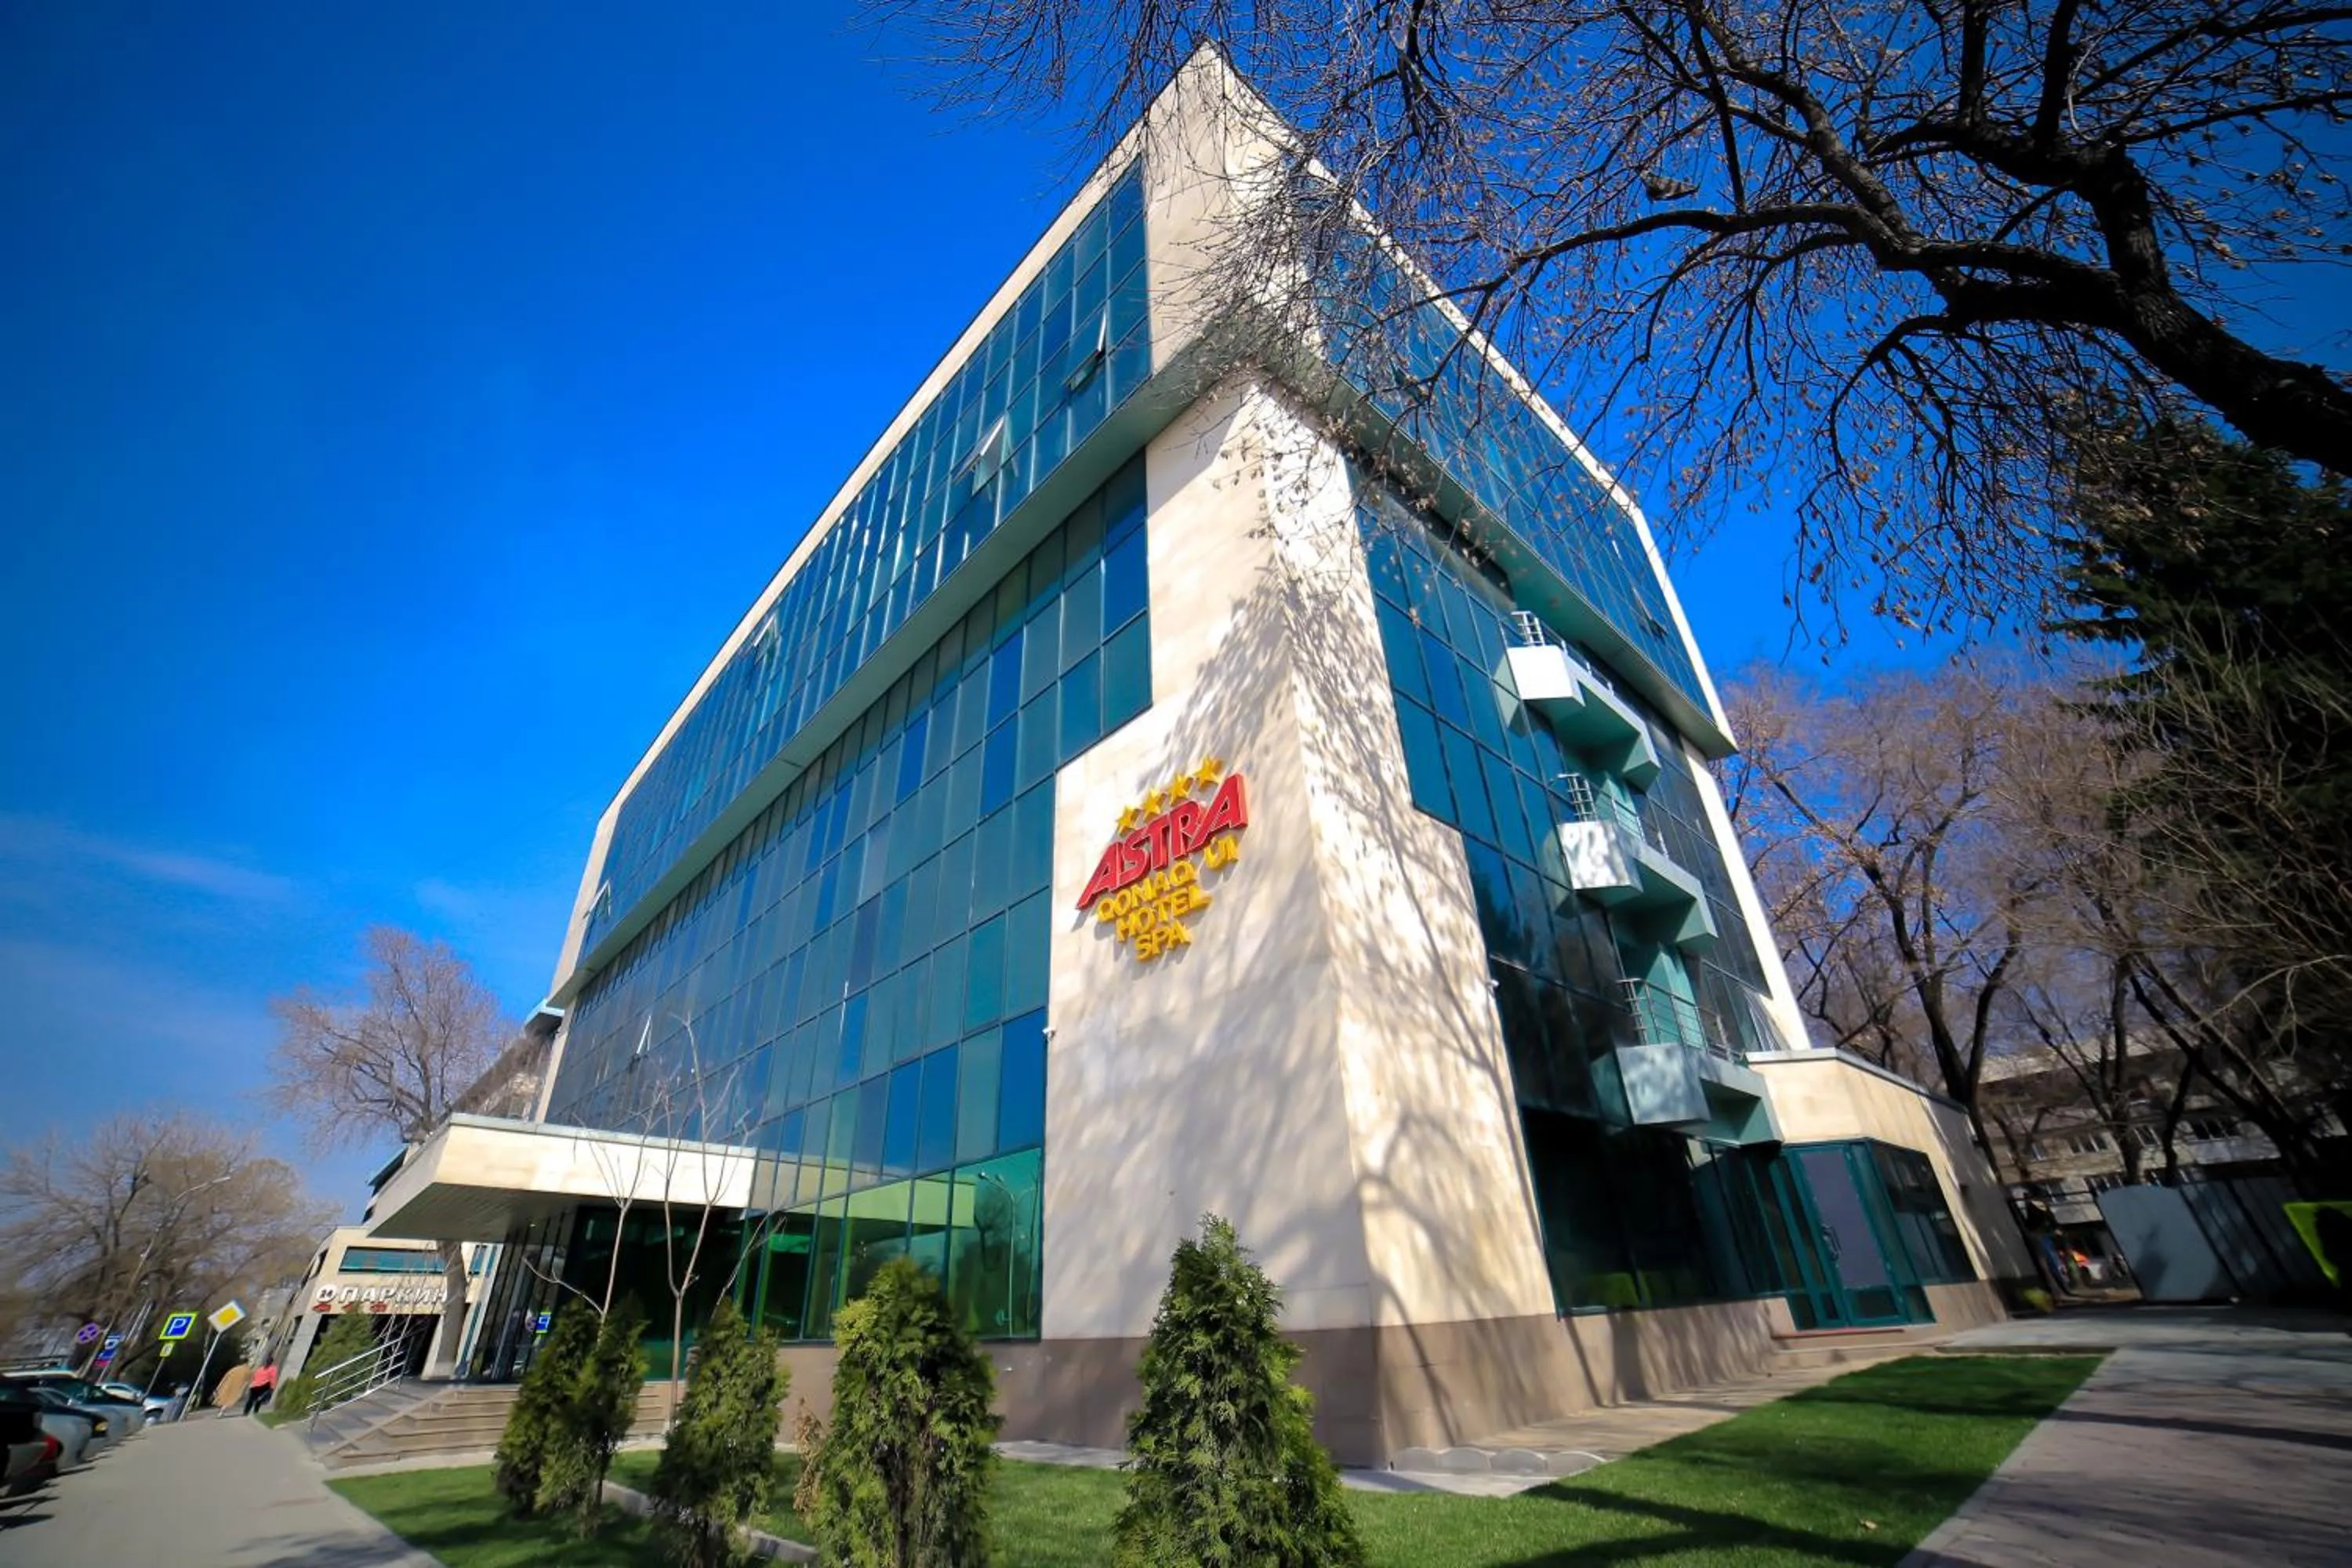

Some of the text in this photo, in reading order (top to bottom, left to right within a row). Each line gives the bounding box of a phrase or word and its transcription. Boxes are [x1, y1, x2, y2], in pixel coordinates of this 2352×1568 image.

[1076, 772, 1248, 909] ASTRA
[1116, 884, 1212, 942] HOTEL
[1136, 919, 1191, 962] SPA
[339, 1287, 448, 1303] ПАРКИН
[167, 1318, 186, 1335] P
